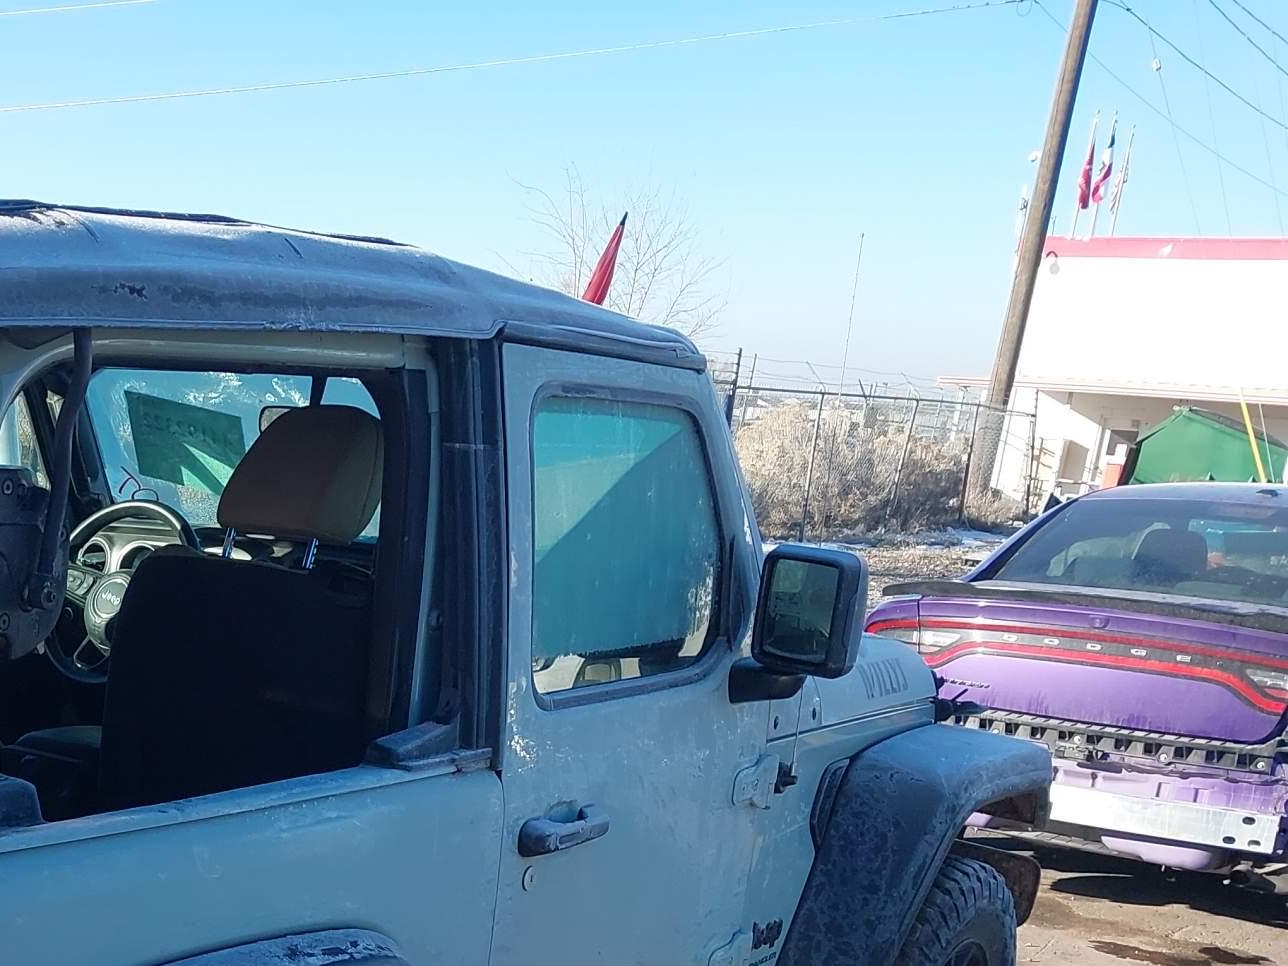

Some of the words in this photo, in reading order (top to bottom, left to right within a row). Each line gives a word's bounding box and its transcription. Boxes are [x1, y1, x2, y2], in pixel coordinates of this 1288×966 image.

[102, 590, 120, 605] Jeep
[1001, 633, 1192, 663] DODGE
[857, 657, 908, 700] WILLYS
